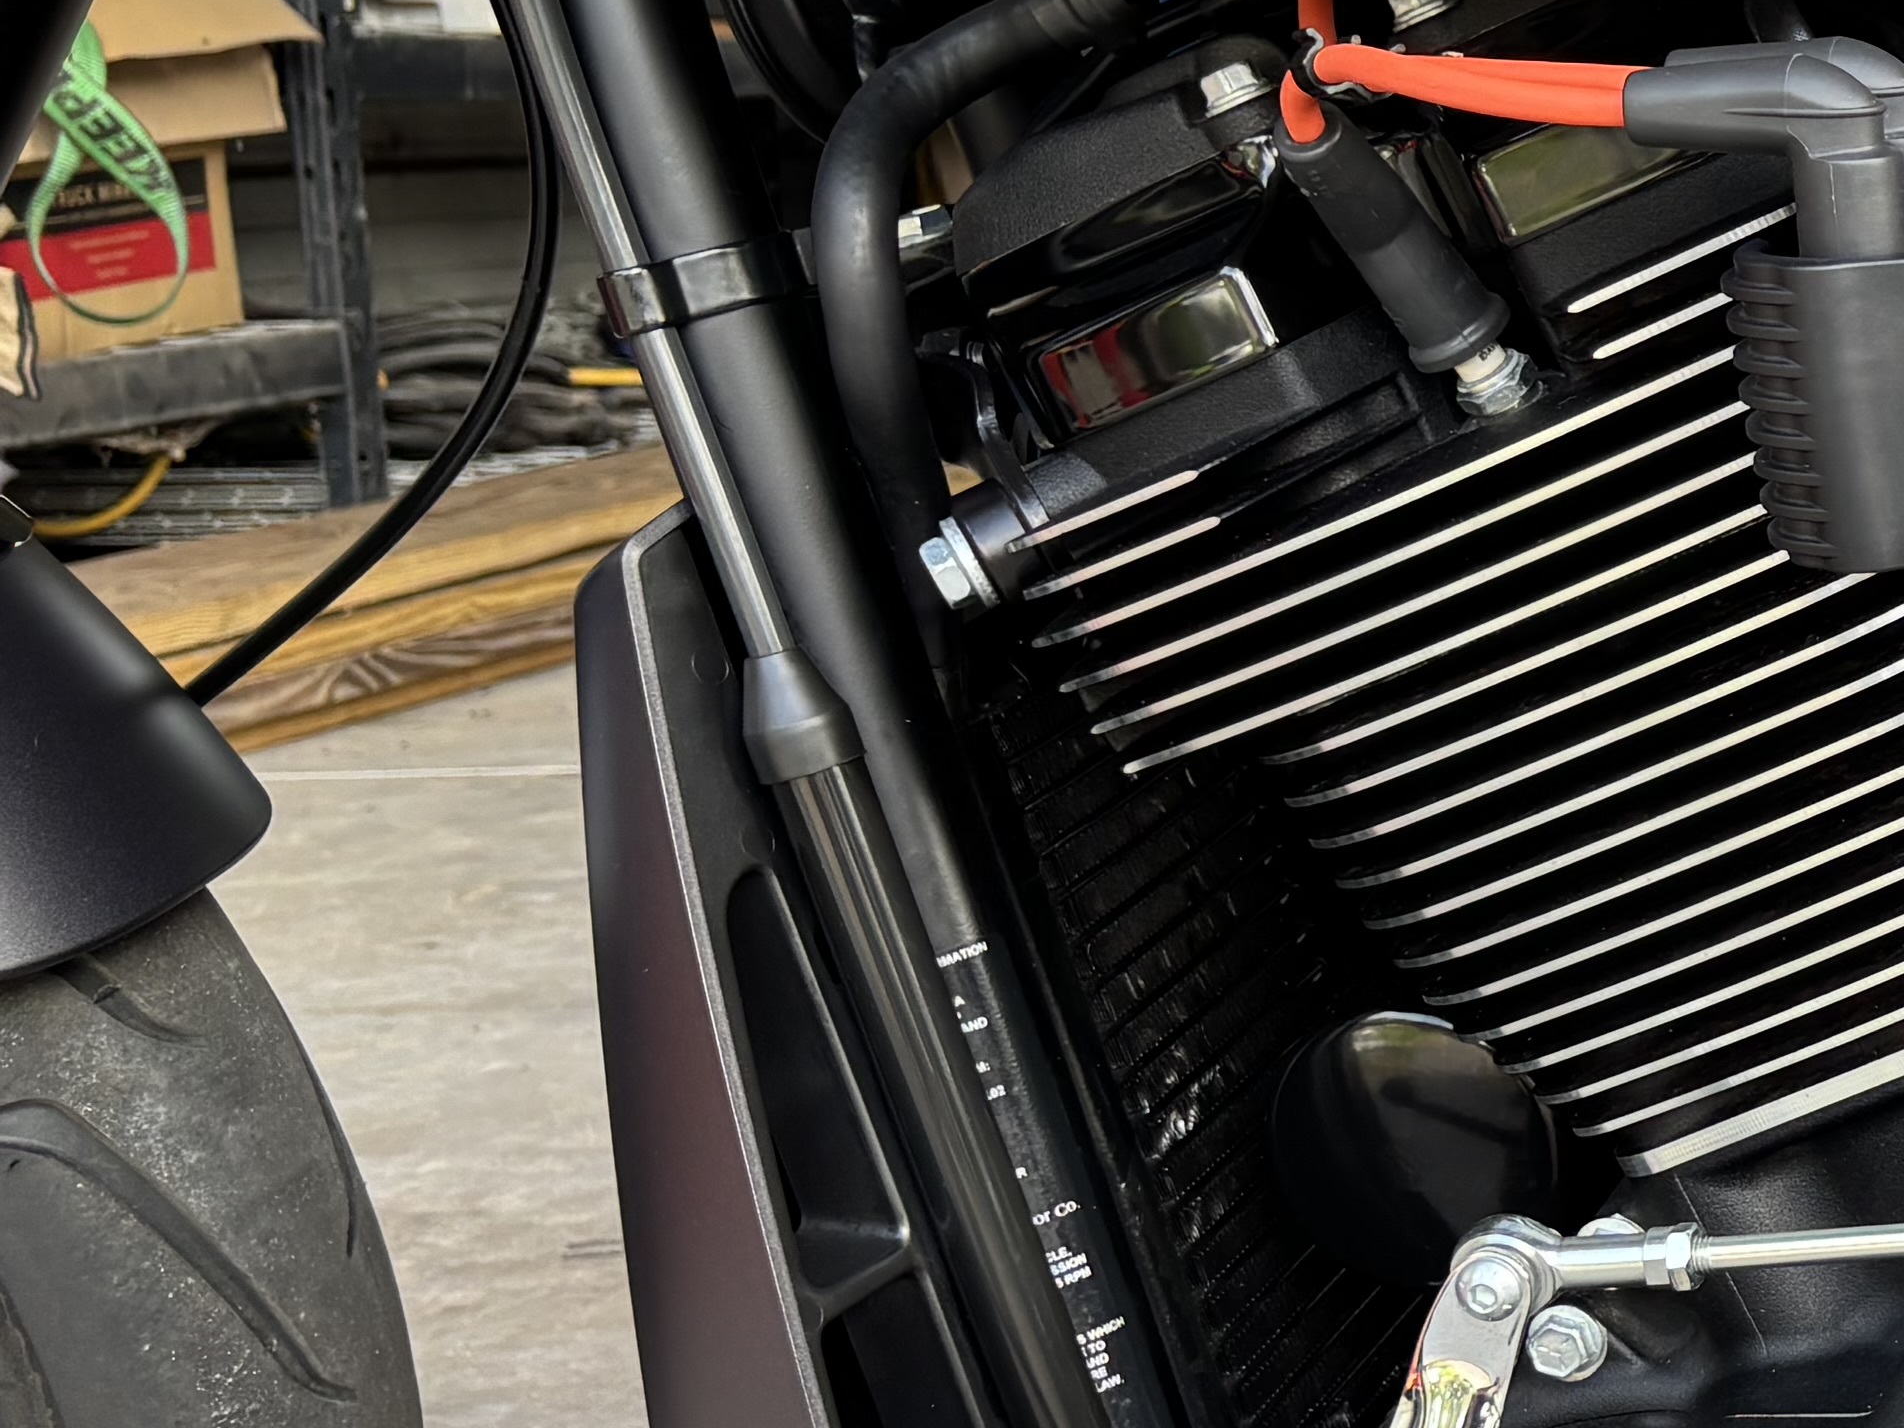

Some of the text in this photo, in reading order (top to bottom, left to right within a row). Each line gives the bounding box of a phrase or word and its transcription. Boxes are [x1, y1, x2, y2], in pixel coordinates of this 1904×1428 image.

[1054, 1200, 1082, 1218] Co.
[1063, 1265, 1093, 1285] RPM
[1086, 1315, 1126, 1341] WHICH
